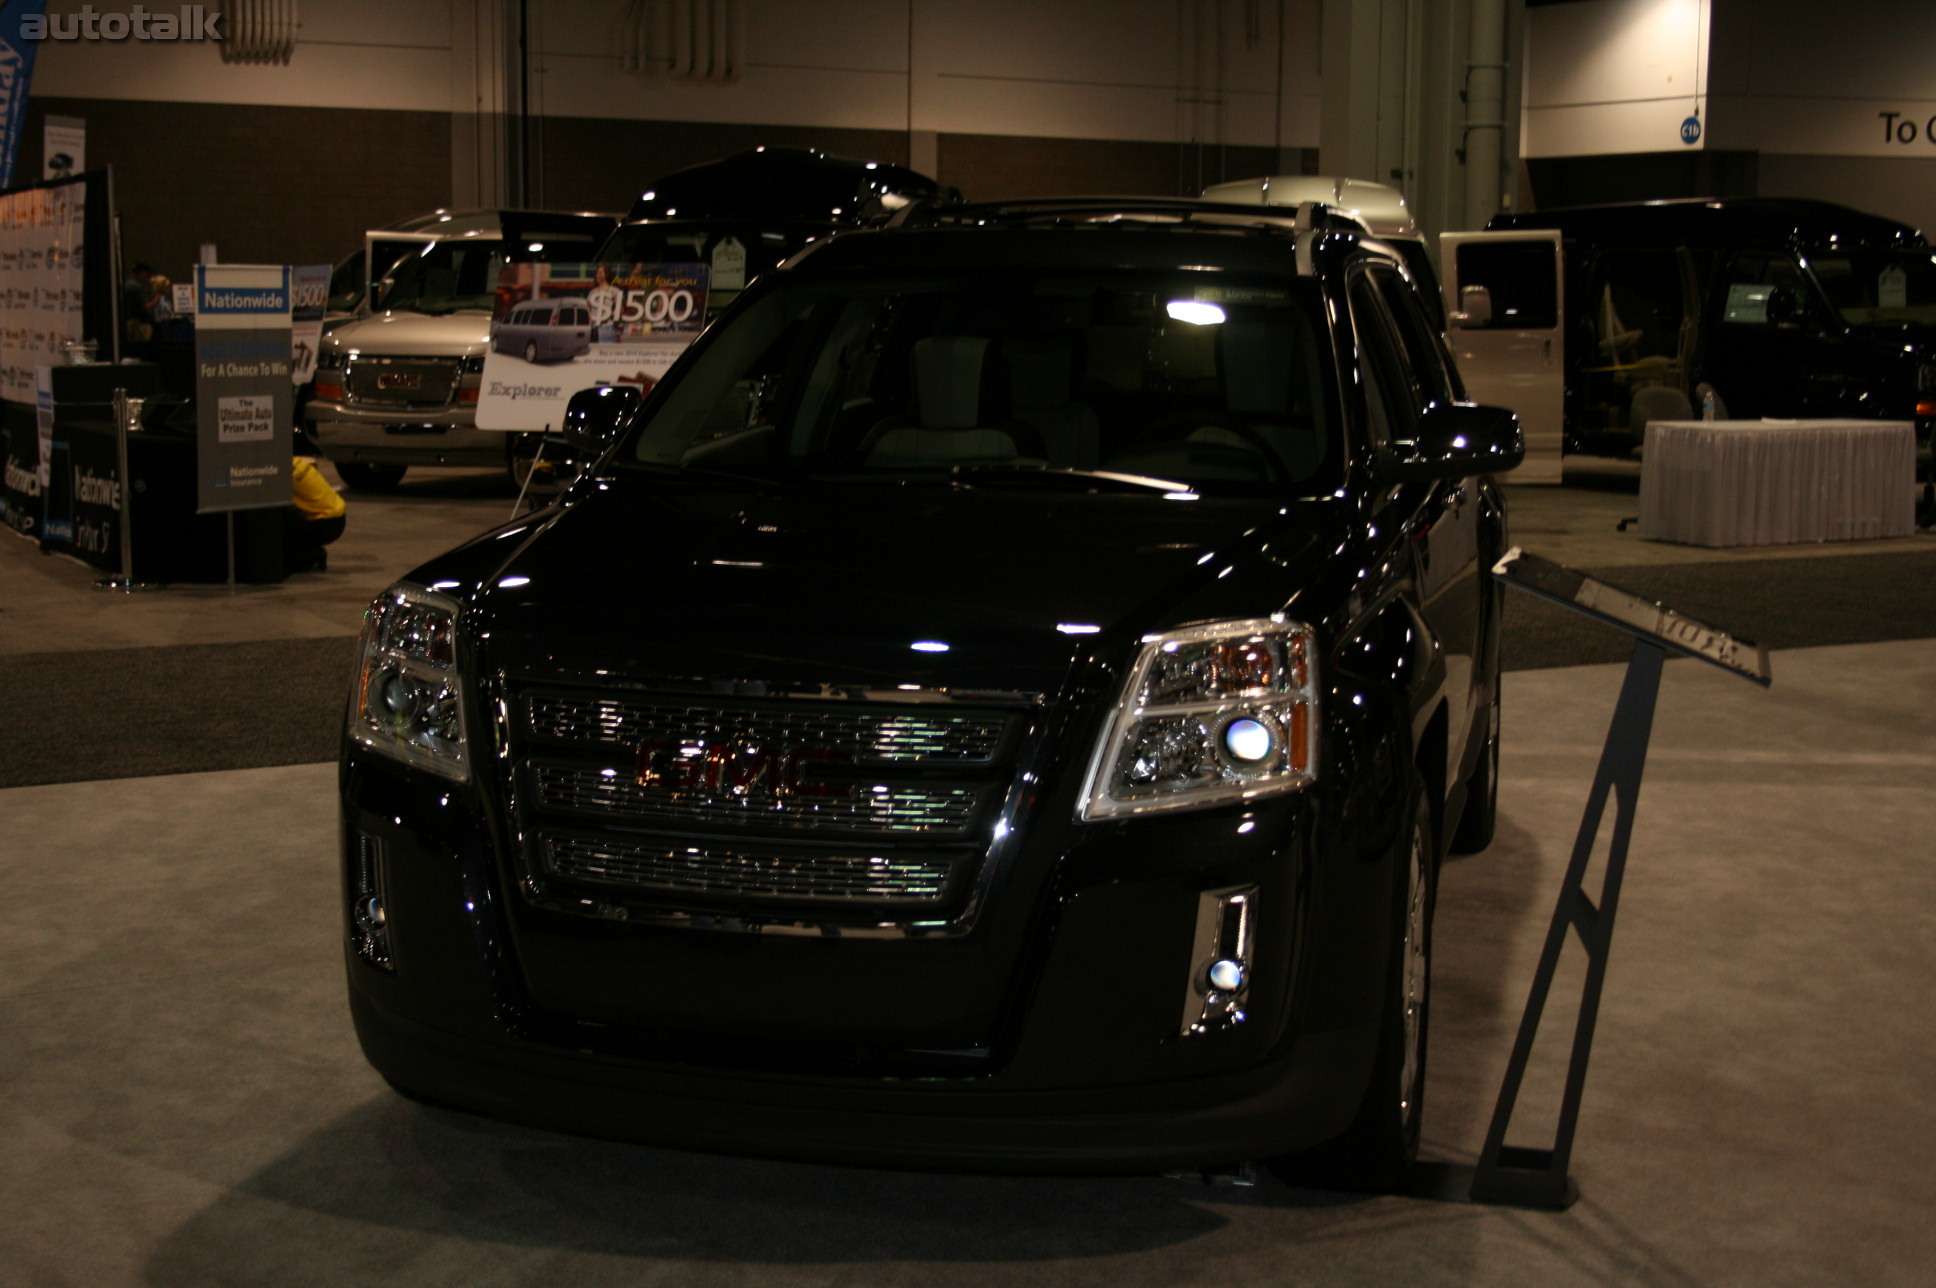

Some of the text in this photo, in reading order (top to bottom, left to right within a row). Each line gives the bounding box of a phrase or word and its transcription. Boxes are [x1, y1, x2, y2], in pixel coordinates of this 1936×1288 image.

[1879, 112, 1917, 144] To
[204, 292, 283, 309] Nationwide
[588, 289, 693, 326] $1500
[201, 361, 288, 378] For A Chance To Win
[488, 381, 561, 399] Explorer
[239, 399, 253, 407] The
[220, 407, 272, 421] Ultimate Auto
[223, 422, 269, 433] Prize Pack
[229, 464, 279, 477] Nationwide
[637, 741, 857, 797] GMC
